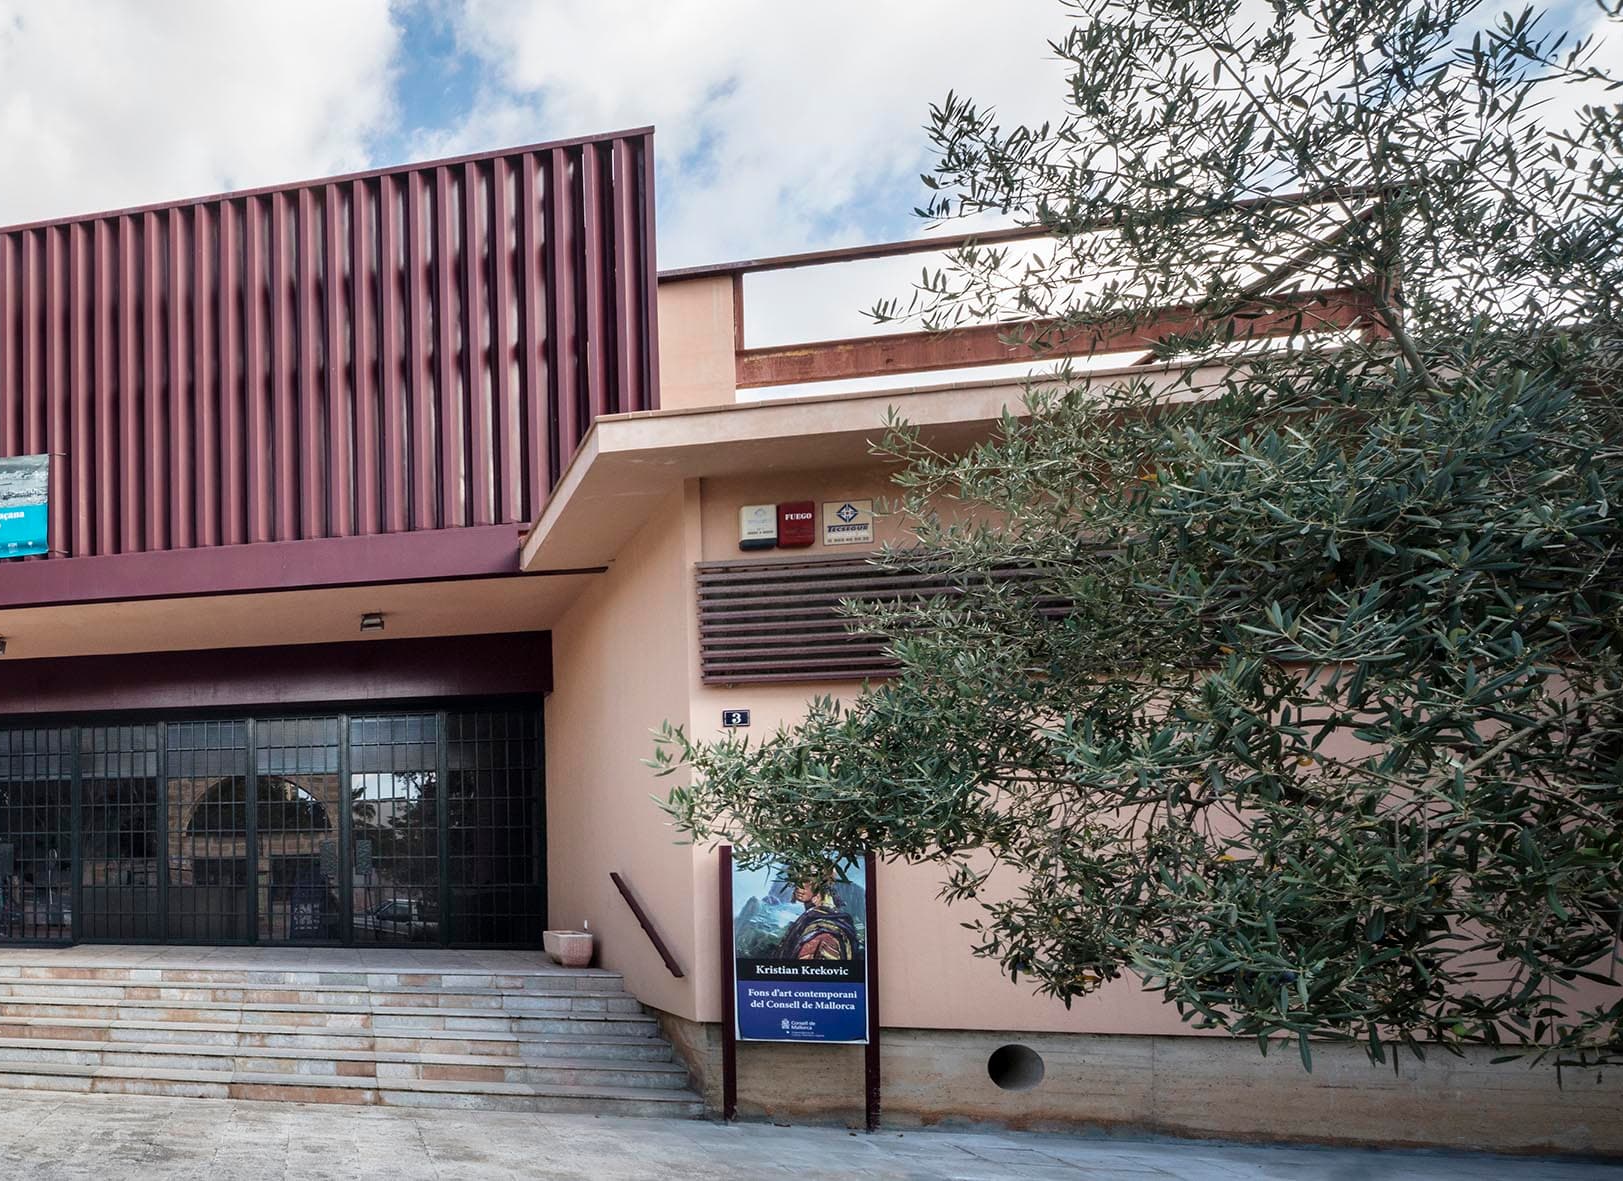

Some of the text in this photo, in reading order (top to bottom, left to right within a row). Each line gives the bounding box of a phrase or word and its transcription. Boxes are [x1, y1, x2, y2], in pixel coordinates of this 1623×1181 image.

[784, 512, 813, 521] FUEGO
[732, 712, 742, 724] 3
[755, 964, 849, 976] Kristian Krekovic
[747, 988, 858, 1001] Fons d'art contemporani
[750, 999, 856, 1010] del Consell de Mallorca
